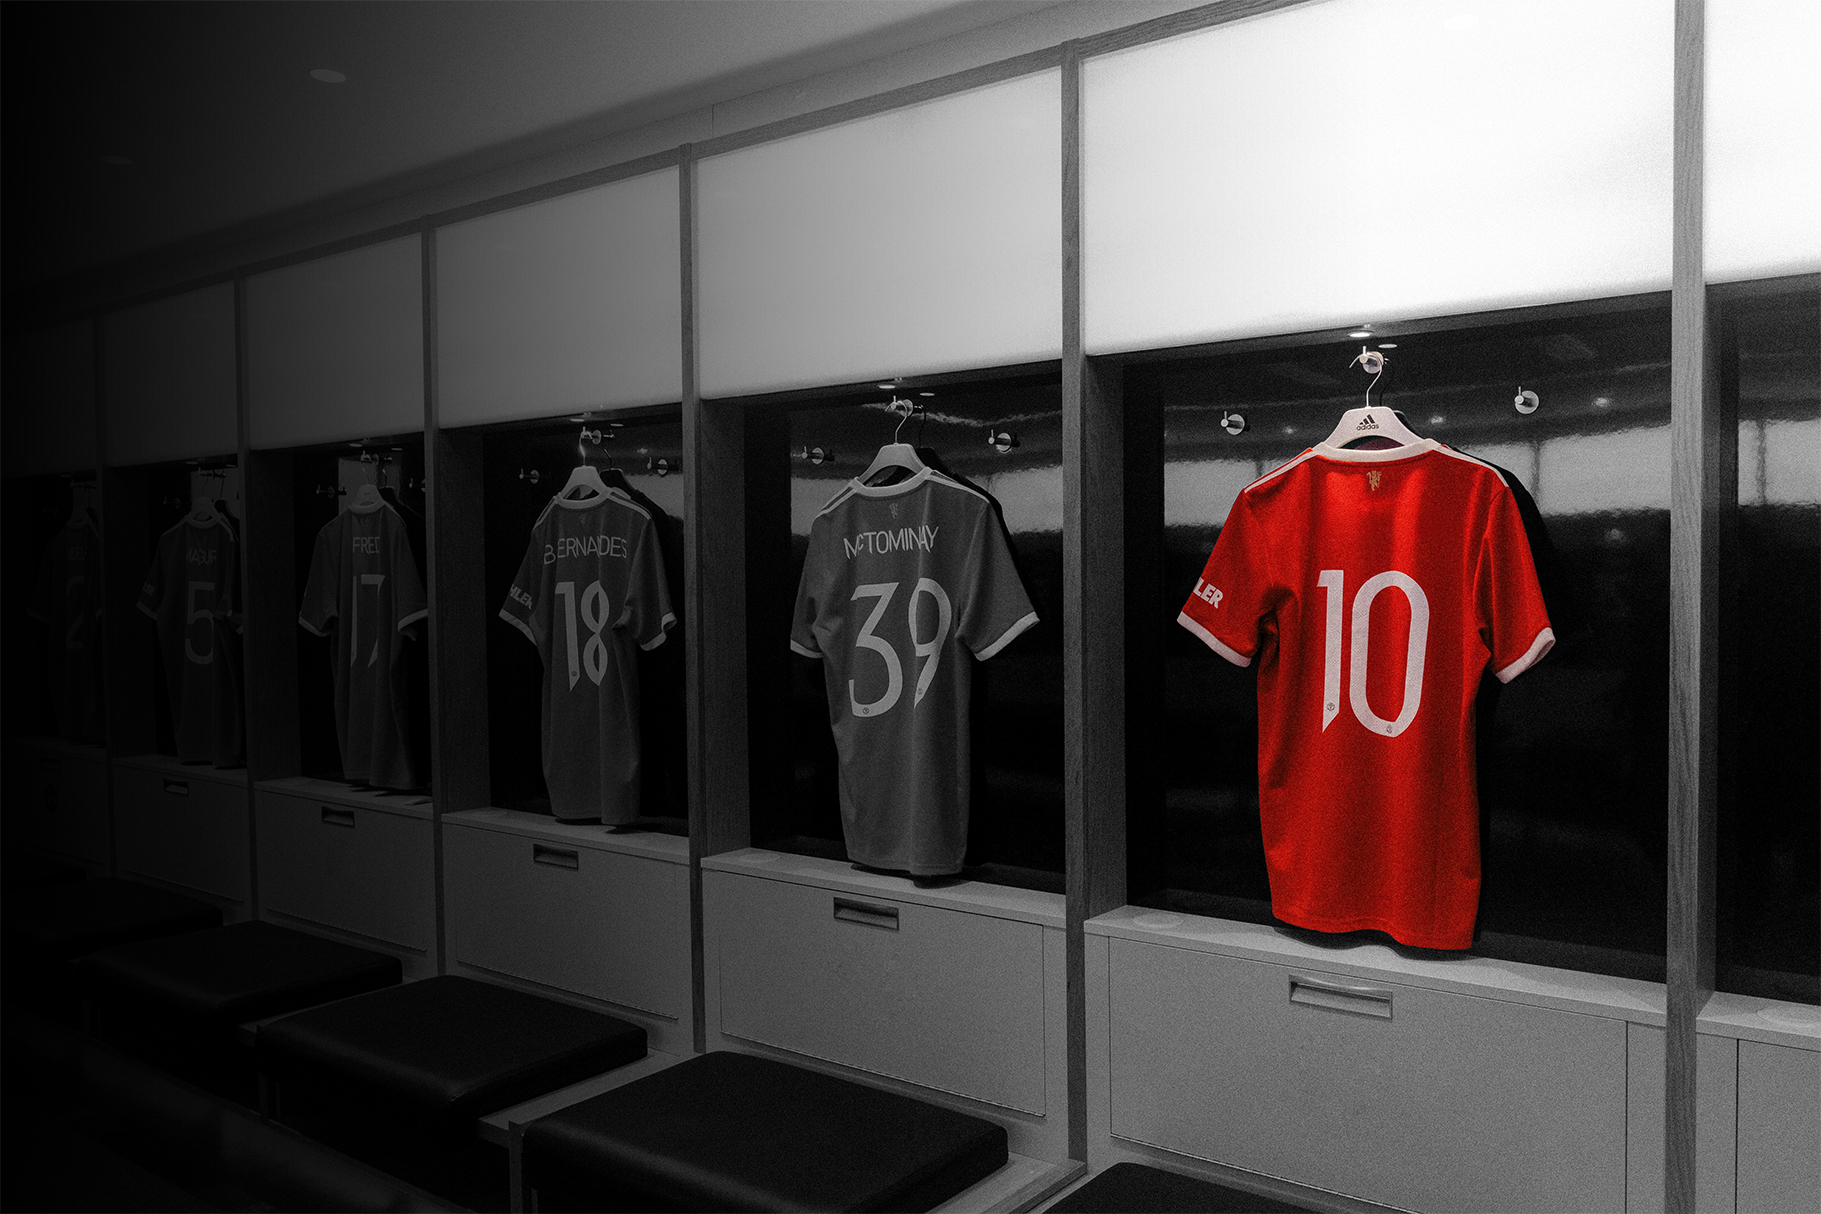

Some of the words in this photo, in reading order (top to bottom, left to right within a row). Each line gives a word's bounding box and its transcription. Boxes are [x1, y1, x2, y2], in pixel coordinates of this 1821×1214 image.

[65, 574, 85, 650] 2
[185, 581, 215, 665] 5
[350, 574, 386, 668] 17
[555, 580, 610, 692] 18
[848, 577, 952, 718] 39
[1316, 569, 1430, 738] 10
